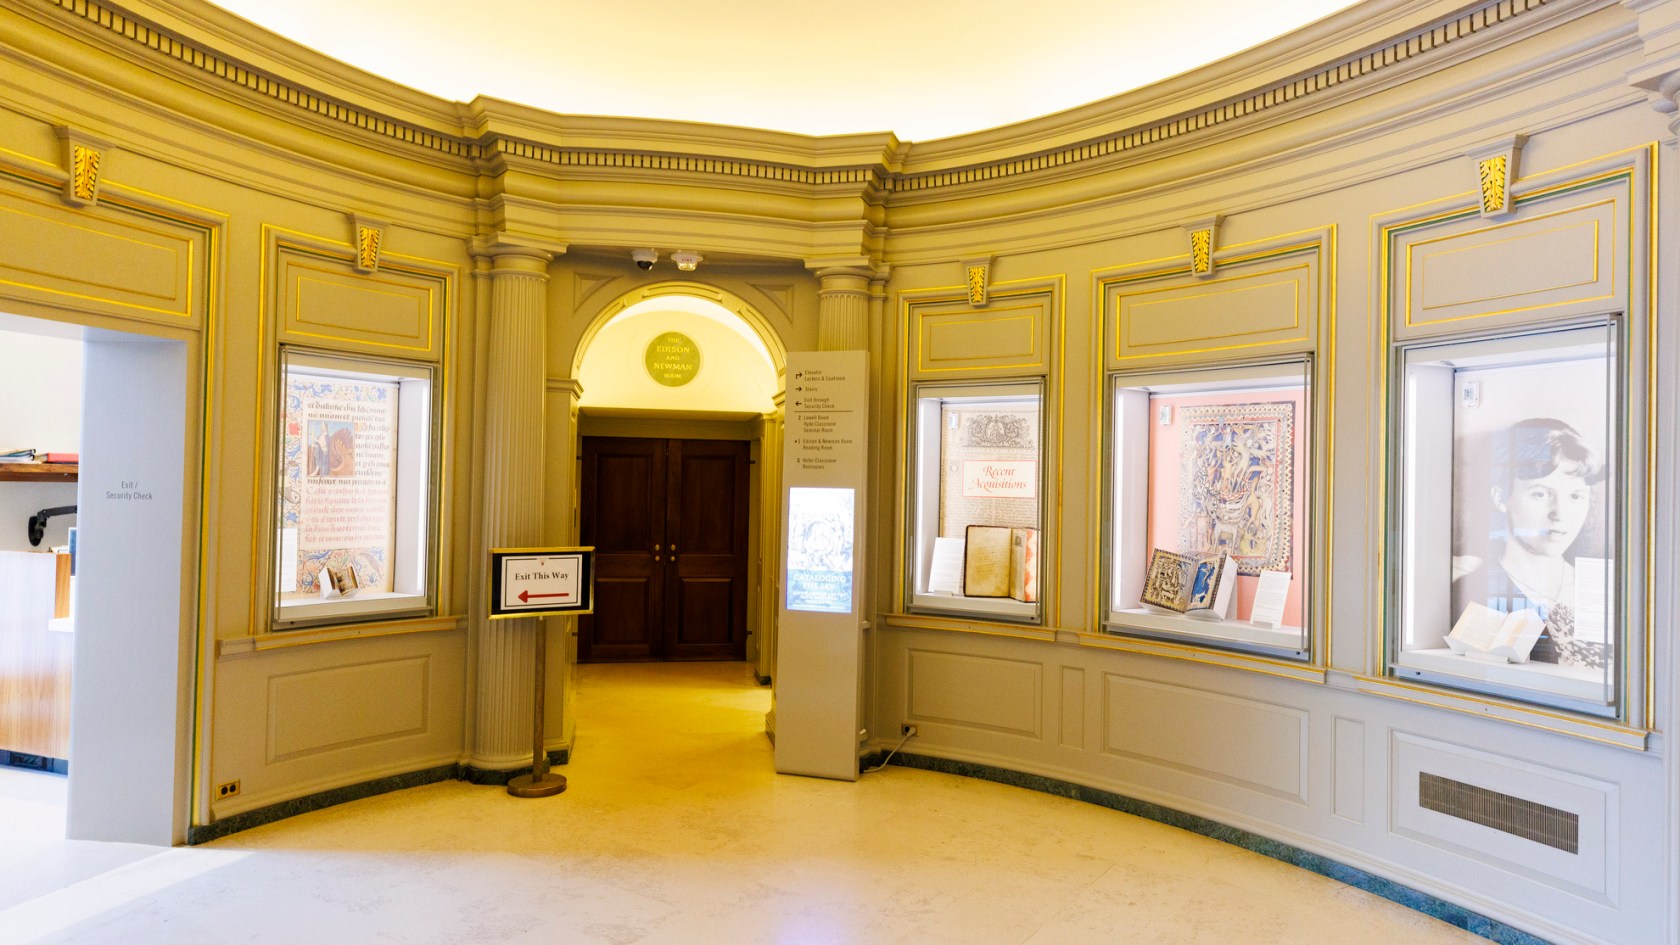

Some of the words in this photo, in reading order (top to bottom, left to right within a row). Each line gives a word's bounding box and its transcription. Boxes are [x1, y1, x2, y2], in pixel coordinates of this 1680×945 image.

[656, 345, 690, 353] EDISON
[654, 362, 692, 371] NEWMAN
[983, 465, 1016, 479] Recent
[121, 480, 133, 489] Exit
[968, 478, 1027, 493] Acquisitions
[106, 491, 132, 500] Security
[133, 492, 152, 500] Check
[515, 572, 531, 580] Exit
[532, 572, 550, 580] This
[552, 571, 570, 580] Way
[794, 573, 846, 584] CATALOGING
